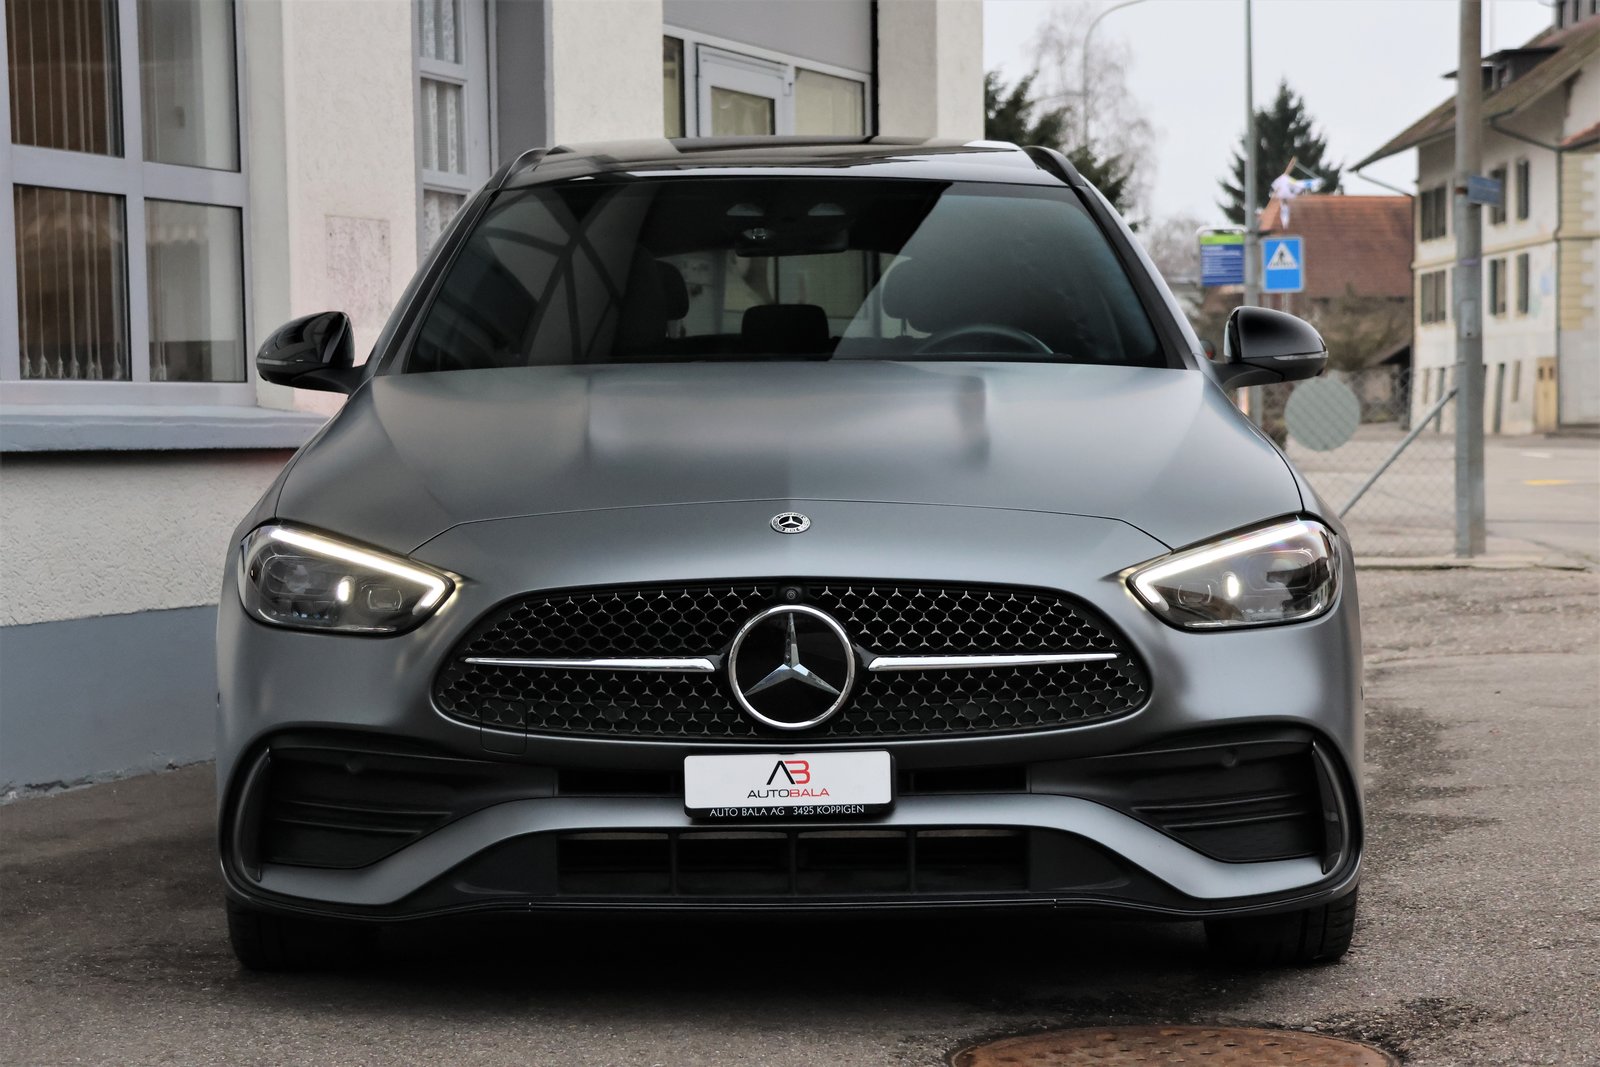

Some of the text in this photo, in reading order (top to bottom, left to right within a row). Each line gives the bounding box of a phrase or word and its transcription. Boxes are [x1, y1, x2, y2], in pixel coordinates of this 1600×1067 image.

[747, 788, 830, 799] AUTOBALA
[709, 804, 865, 817] AUTO BALA AG 3425 KOPPIGEN
